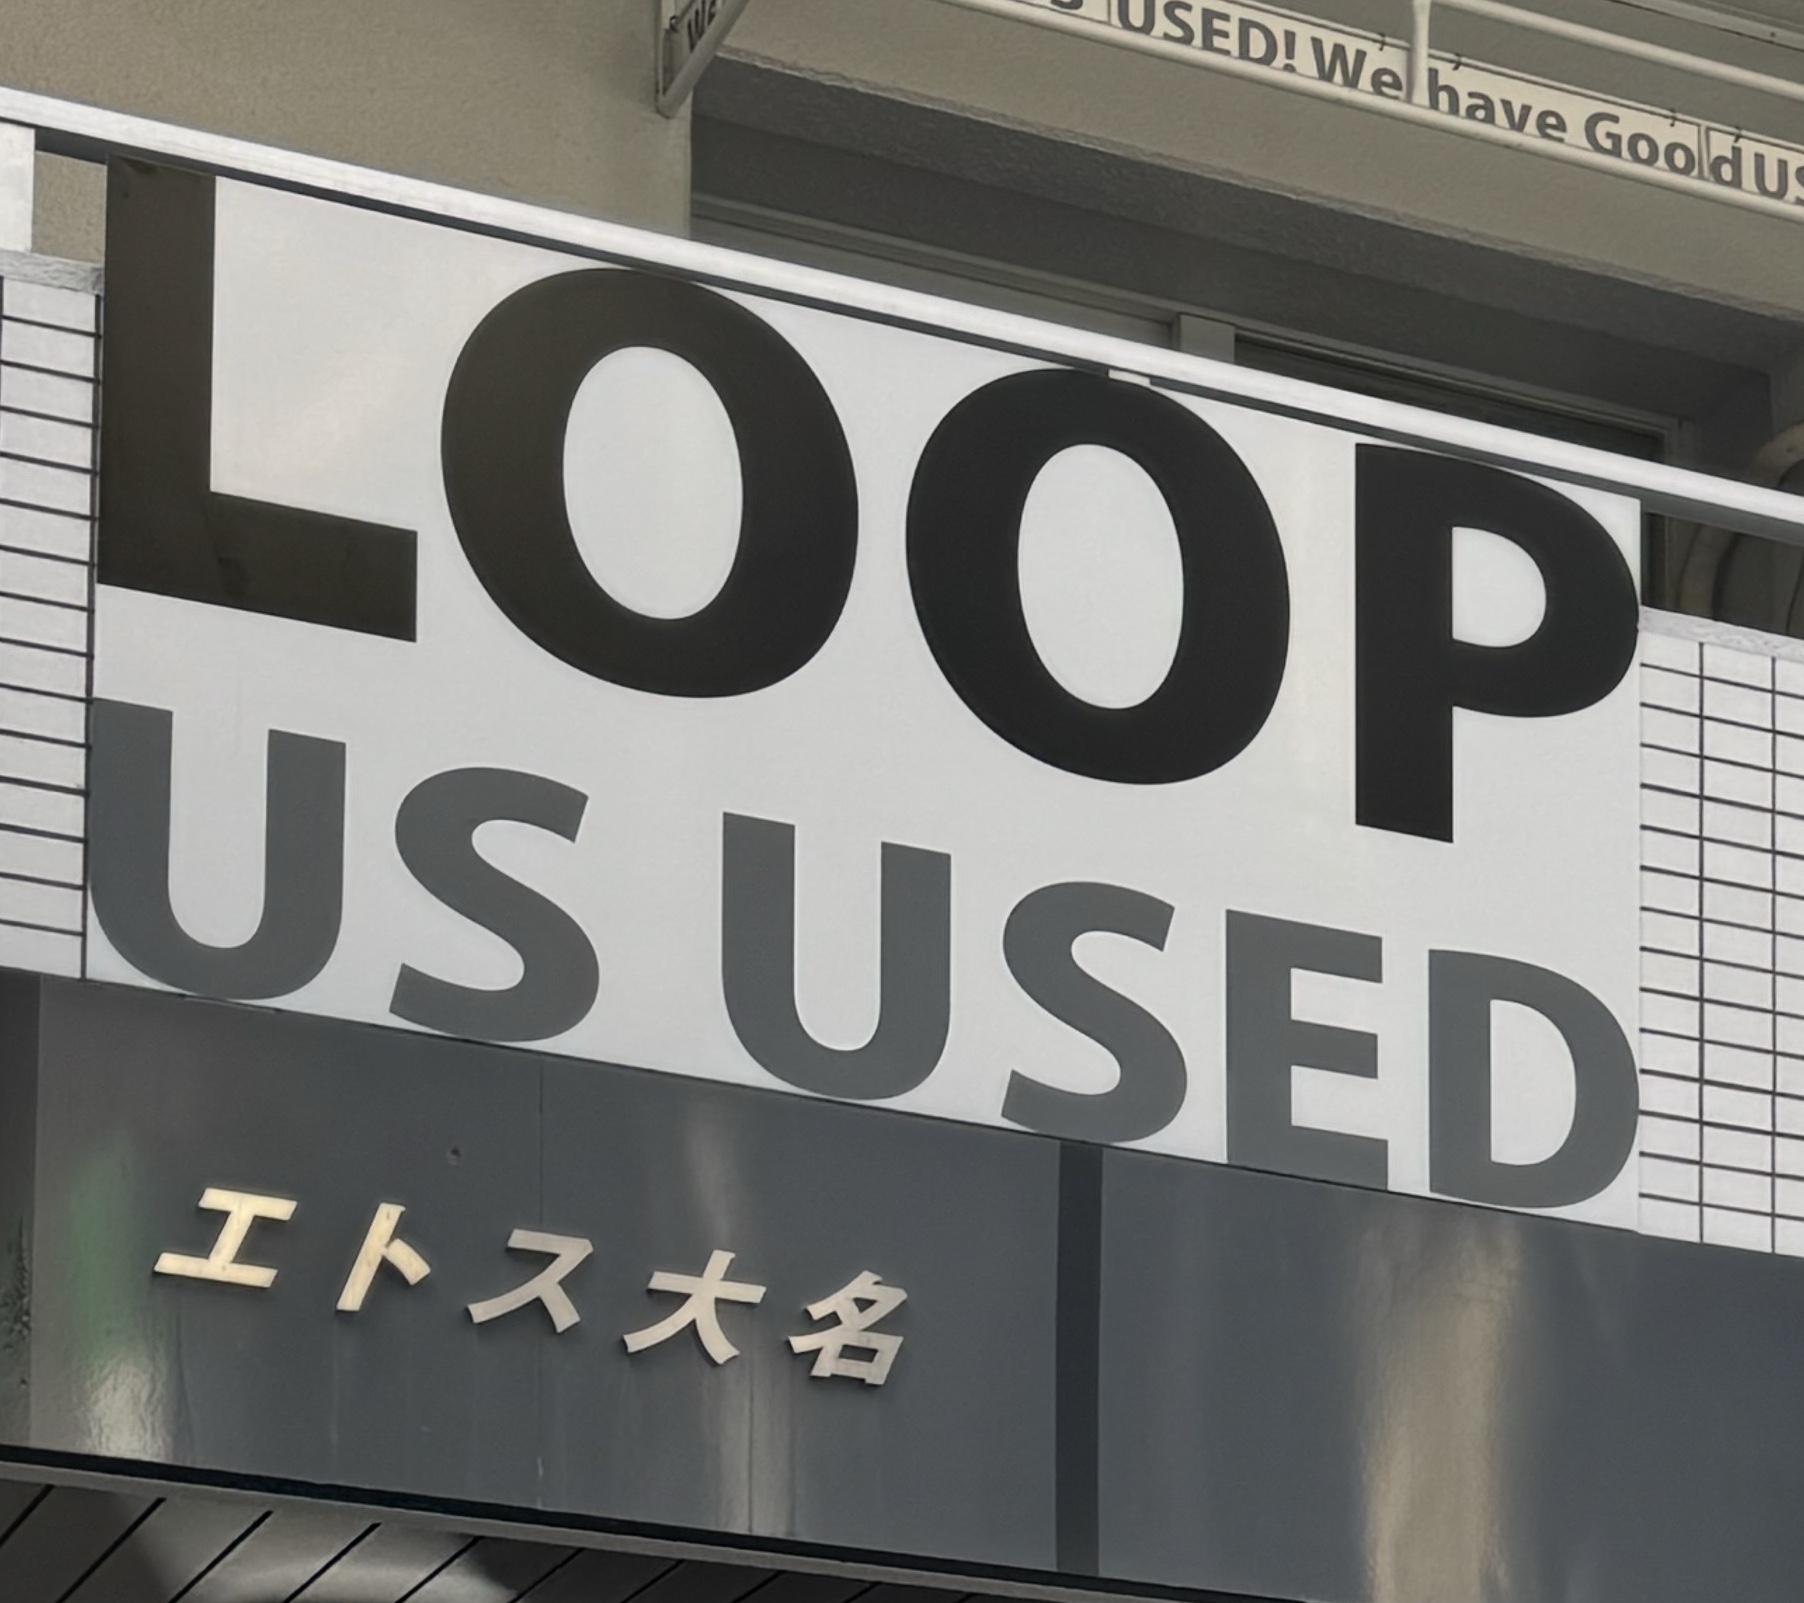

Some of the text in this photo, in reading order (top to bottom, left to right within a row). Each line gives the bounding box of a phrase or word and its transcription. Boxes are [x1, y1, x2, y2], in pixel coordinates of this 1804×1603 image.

[1118, 0, 1298, 73] USED!
[1311, 36, 1404, 100] We
[1428, 68, 1568, 144] have
[1583, 112, 1742, 189] Good
[97, 156, 1640, 842] LOOP
[88, 697, 1639, 1209] US USED
[153, 1187, 908, 1385] エトス大名
